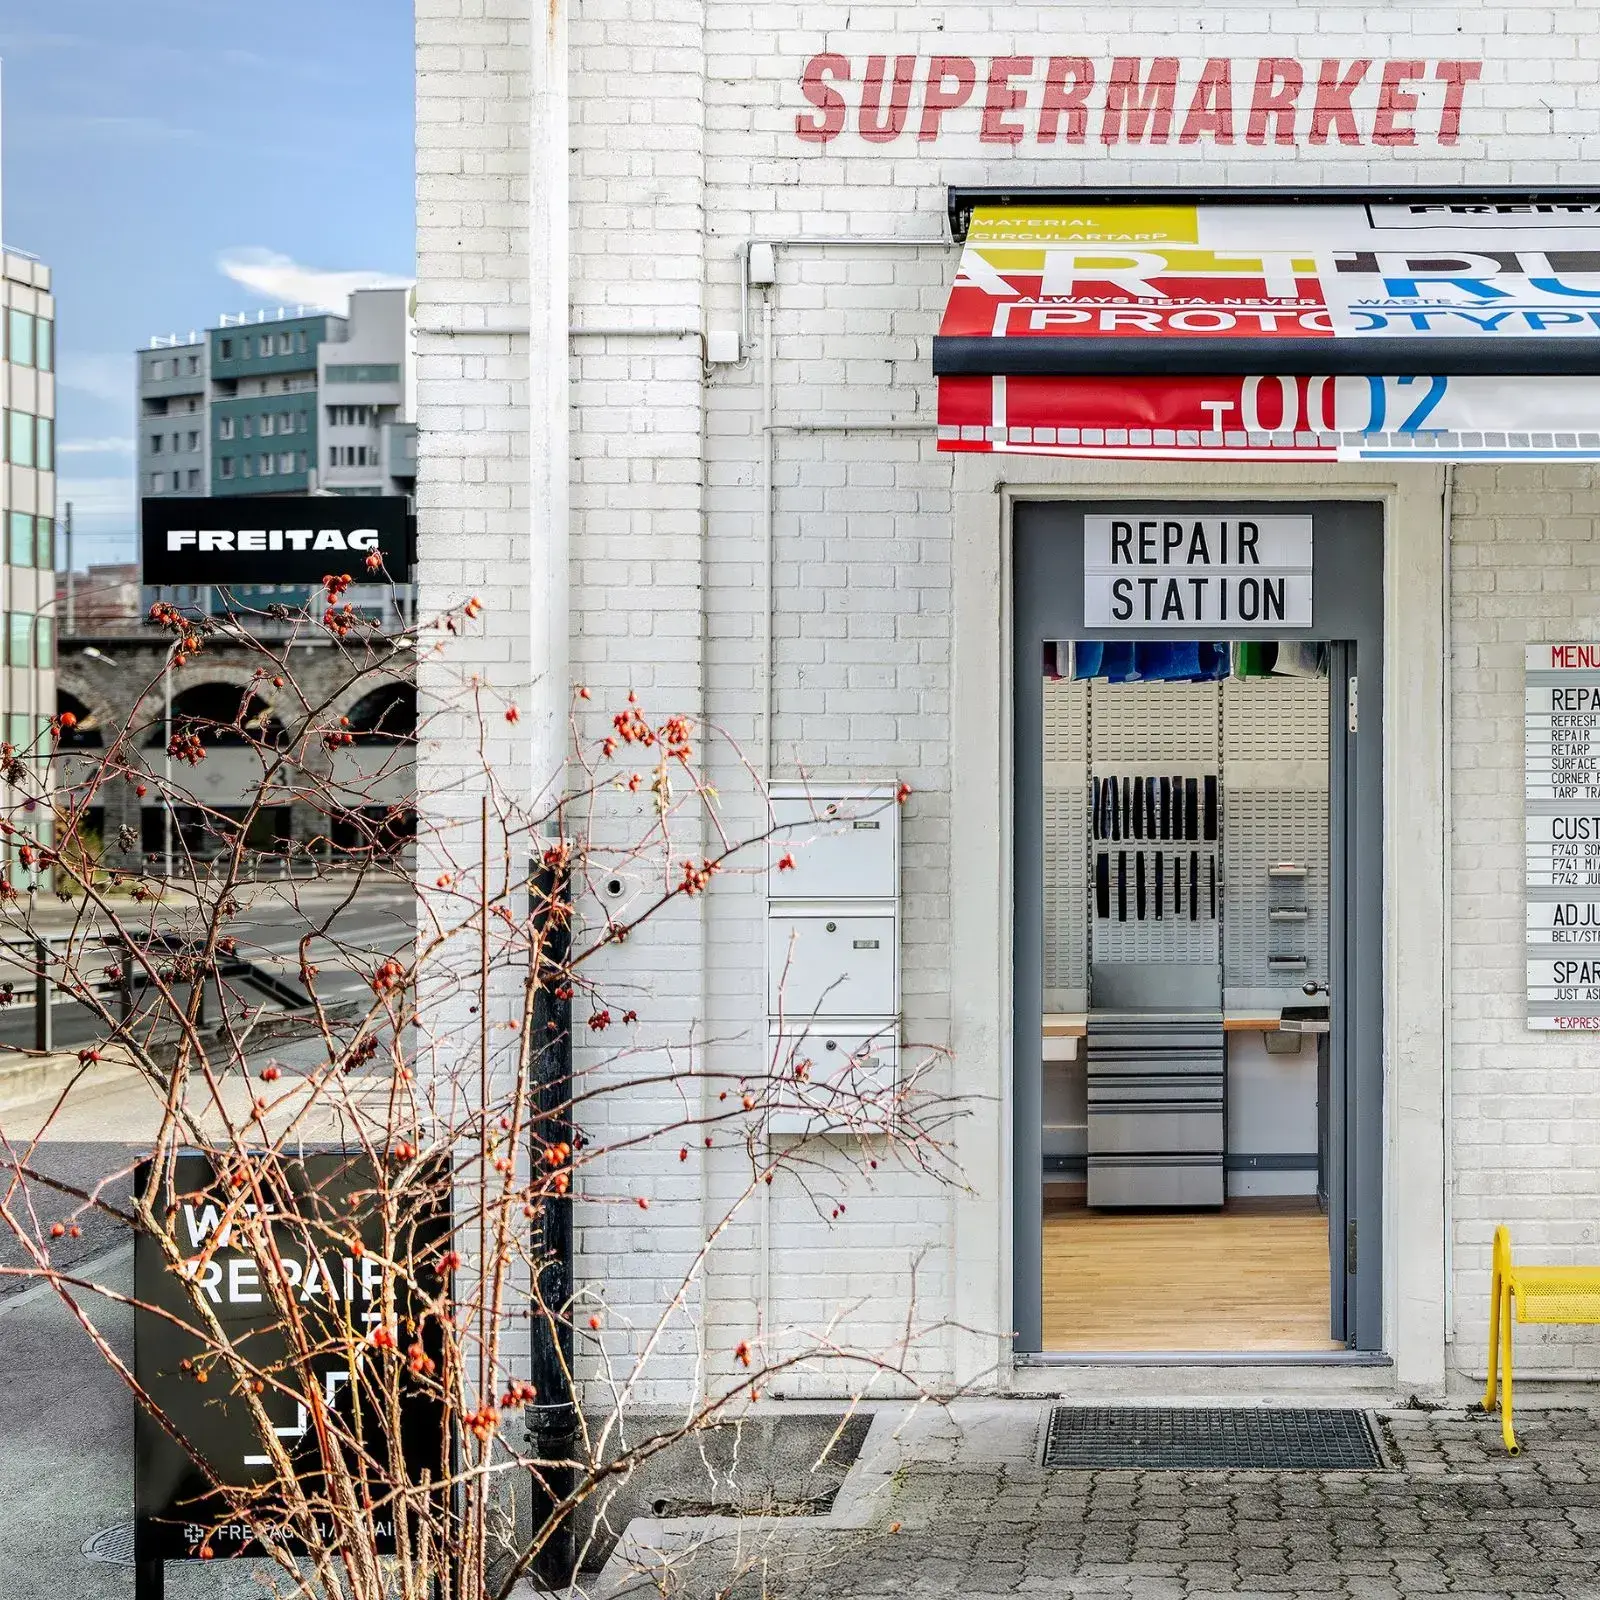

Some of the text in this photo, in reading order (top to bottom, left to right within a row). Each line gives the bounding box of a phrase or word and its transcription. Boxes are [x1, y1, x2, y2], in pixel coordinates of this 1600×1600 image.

[795, 52, 1483, 146] SUPERMARKET
[1409, 204, 1600, 215] FREIT
[972, 218, 1100, 227] MATERIAL
[1017, 296, 1129, 304] ALWAYS
[1223, 298, 1318, 306] NEVER
[1028, 308, 1600, 333] PROTOTYP
[167, 529, 379, 551] FREITAG
[1111, 521, 1260, 565] REPAIR
[1112, 577, 1285, 621] STATION
[1551, 645, 1600, 668] MENU
[1552, 688, 1600, 711] REPA
[1551, 715, 1597, 727] REFRESH
[1551, 730, 1591, 741] REPAIR
[1551, 744, 1591, 756] RETARP
[1551, 758, 1597, 770] SURFACE
[1551, 772, 1591, 784] CORNER
[1552, 787, 1600, 798] TARP TR
[1551, 817, 1600, 840] CUST
[1551, 844, 1600, 856] F740 SO
[1552, 858, 1600, 870] F741 MI
[1552, 872, 1600, 885] F742 JU
[1553, 903, 1600, 926] ADJU
[1552, 930, 1600, 943] BELT/ST
[1553, 961, 1600, 984] SPAR
[1553, 988, 1600, 1000] JUST AS
[1554, 1016, 1600, 1029] EXPRES
